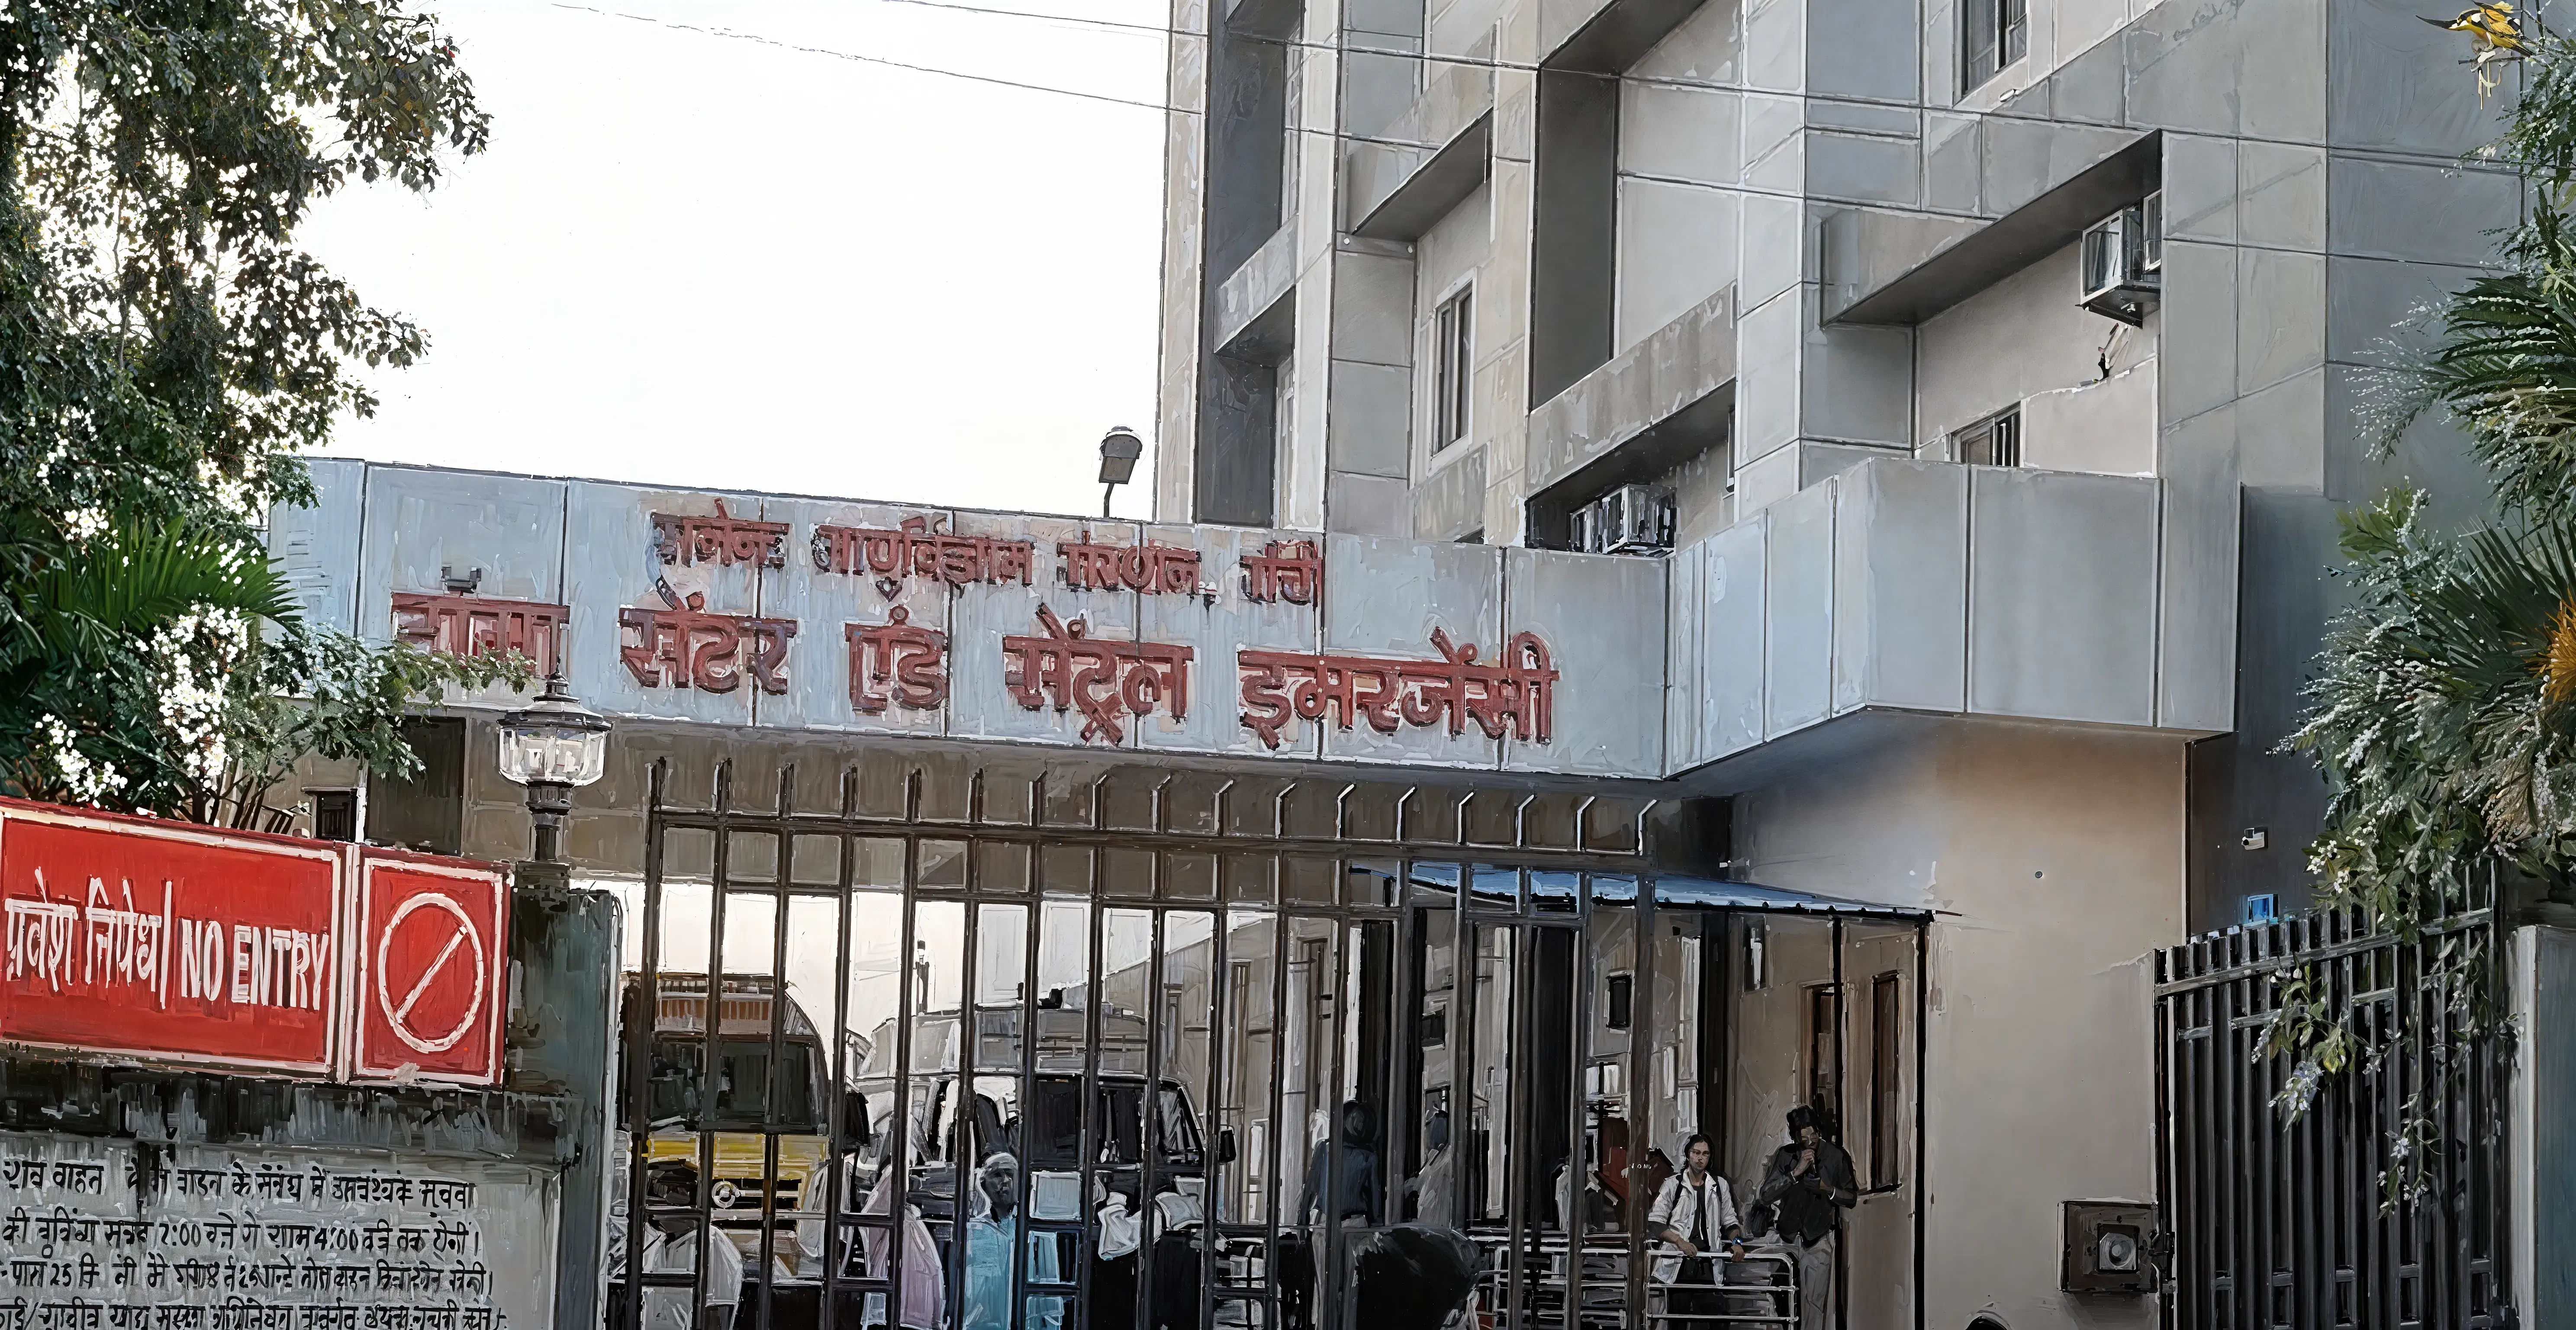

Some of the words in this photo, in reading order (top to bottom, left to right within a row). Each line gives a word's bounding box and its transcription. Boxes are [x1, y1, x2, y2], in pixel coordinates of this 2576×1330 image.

[1238, 632, 1559, 750] इमरजेंसी
[182, 918, 224, 1001] NO
[232, 925, 329, 1010] ENTRY
[50, 1263, 72, 1287] 25
